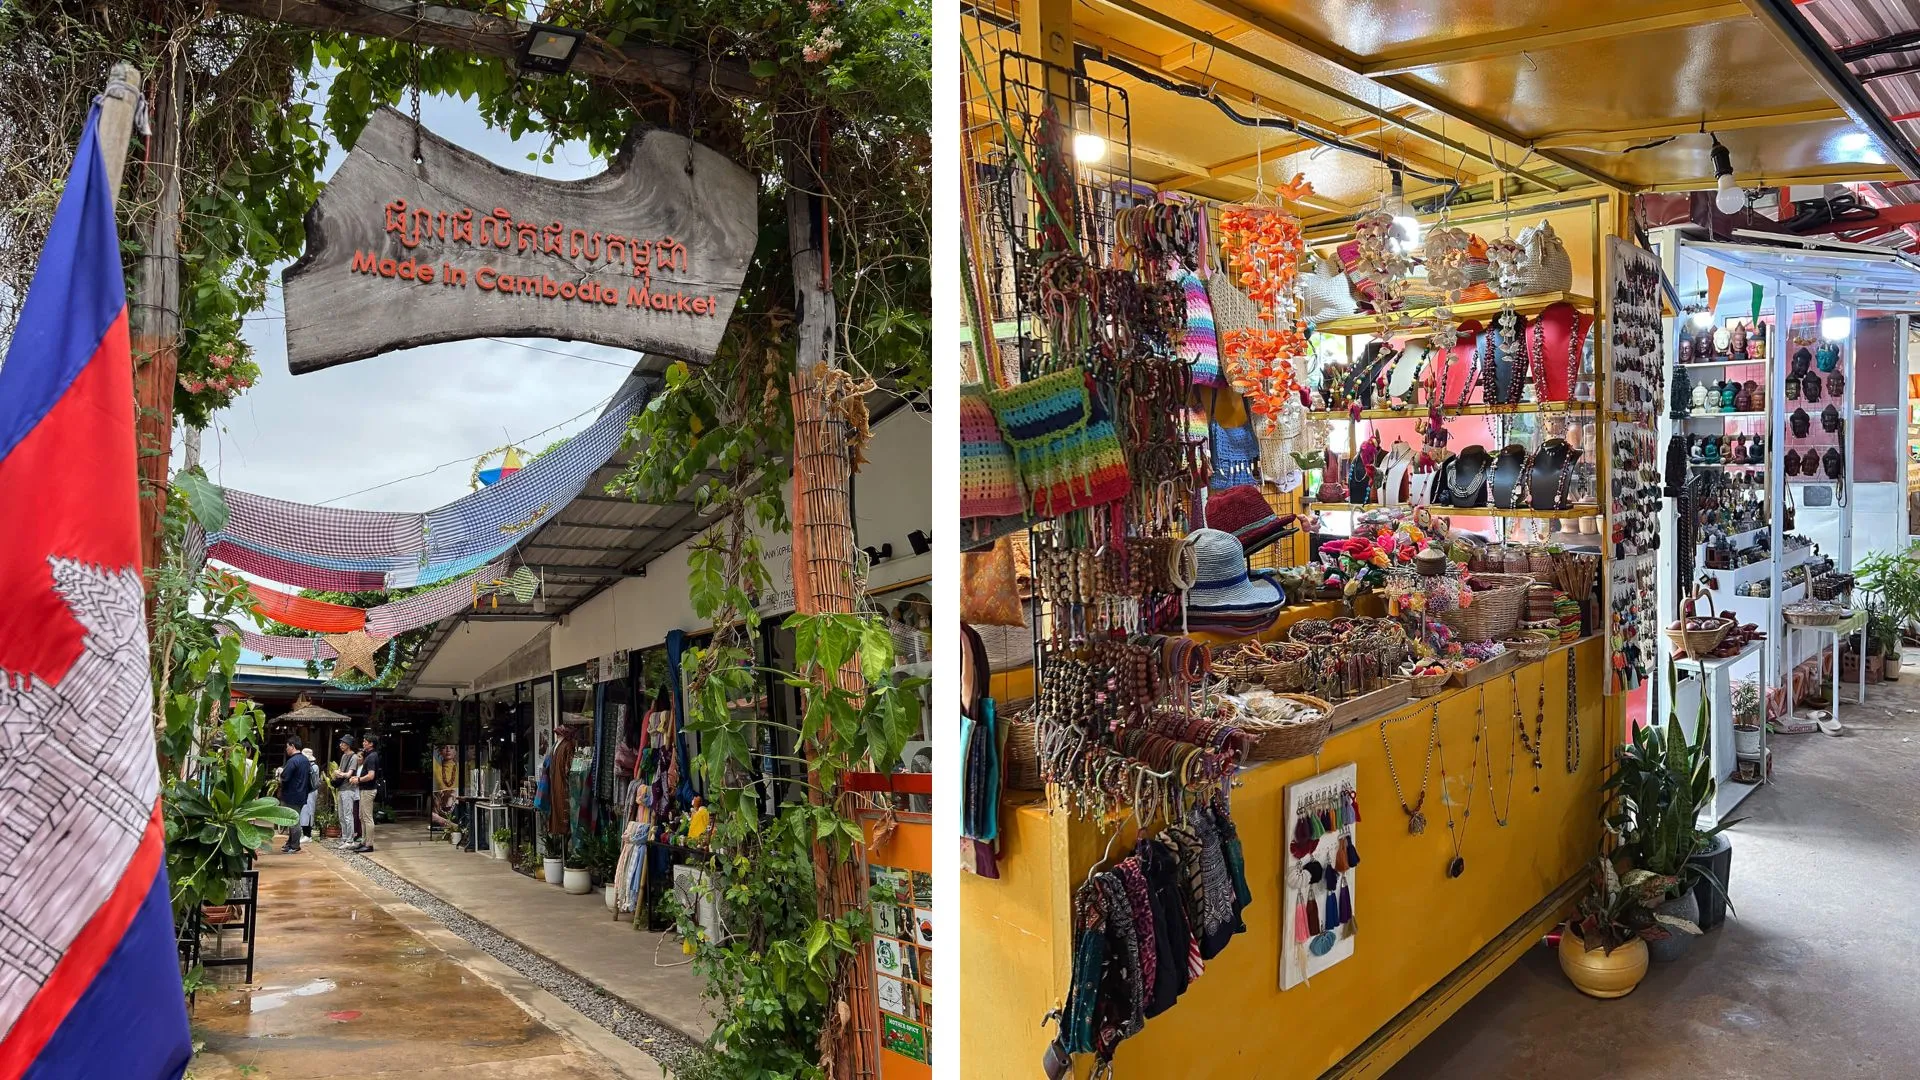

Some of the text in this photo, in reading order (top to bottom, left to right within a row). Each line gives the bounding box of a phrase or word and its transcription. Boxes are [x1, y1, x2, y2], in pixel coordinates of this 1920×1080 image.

[351, 249, 717, 317] Made in Cambodia Market
